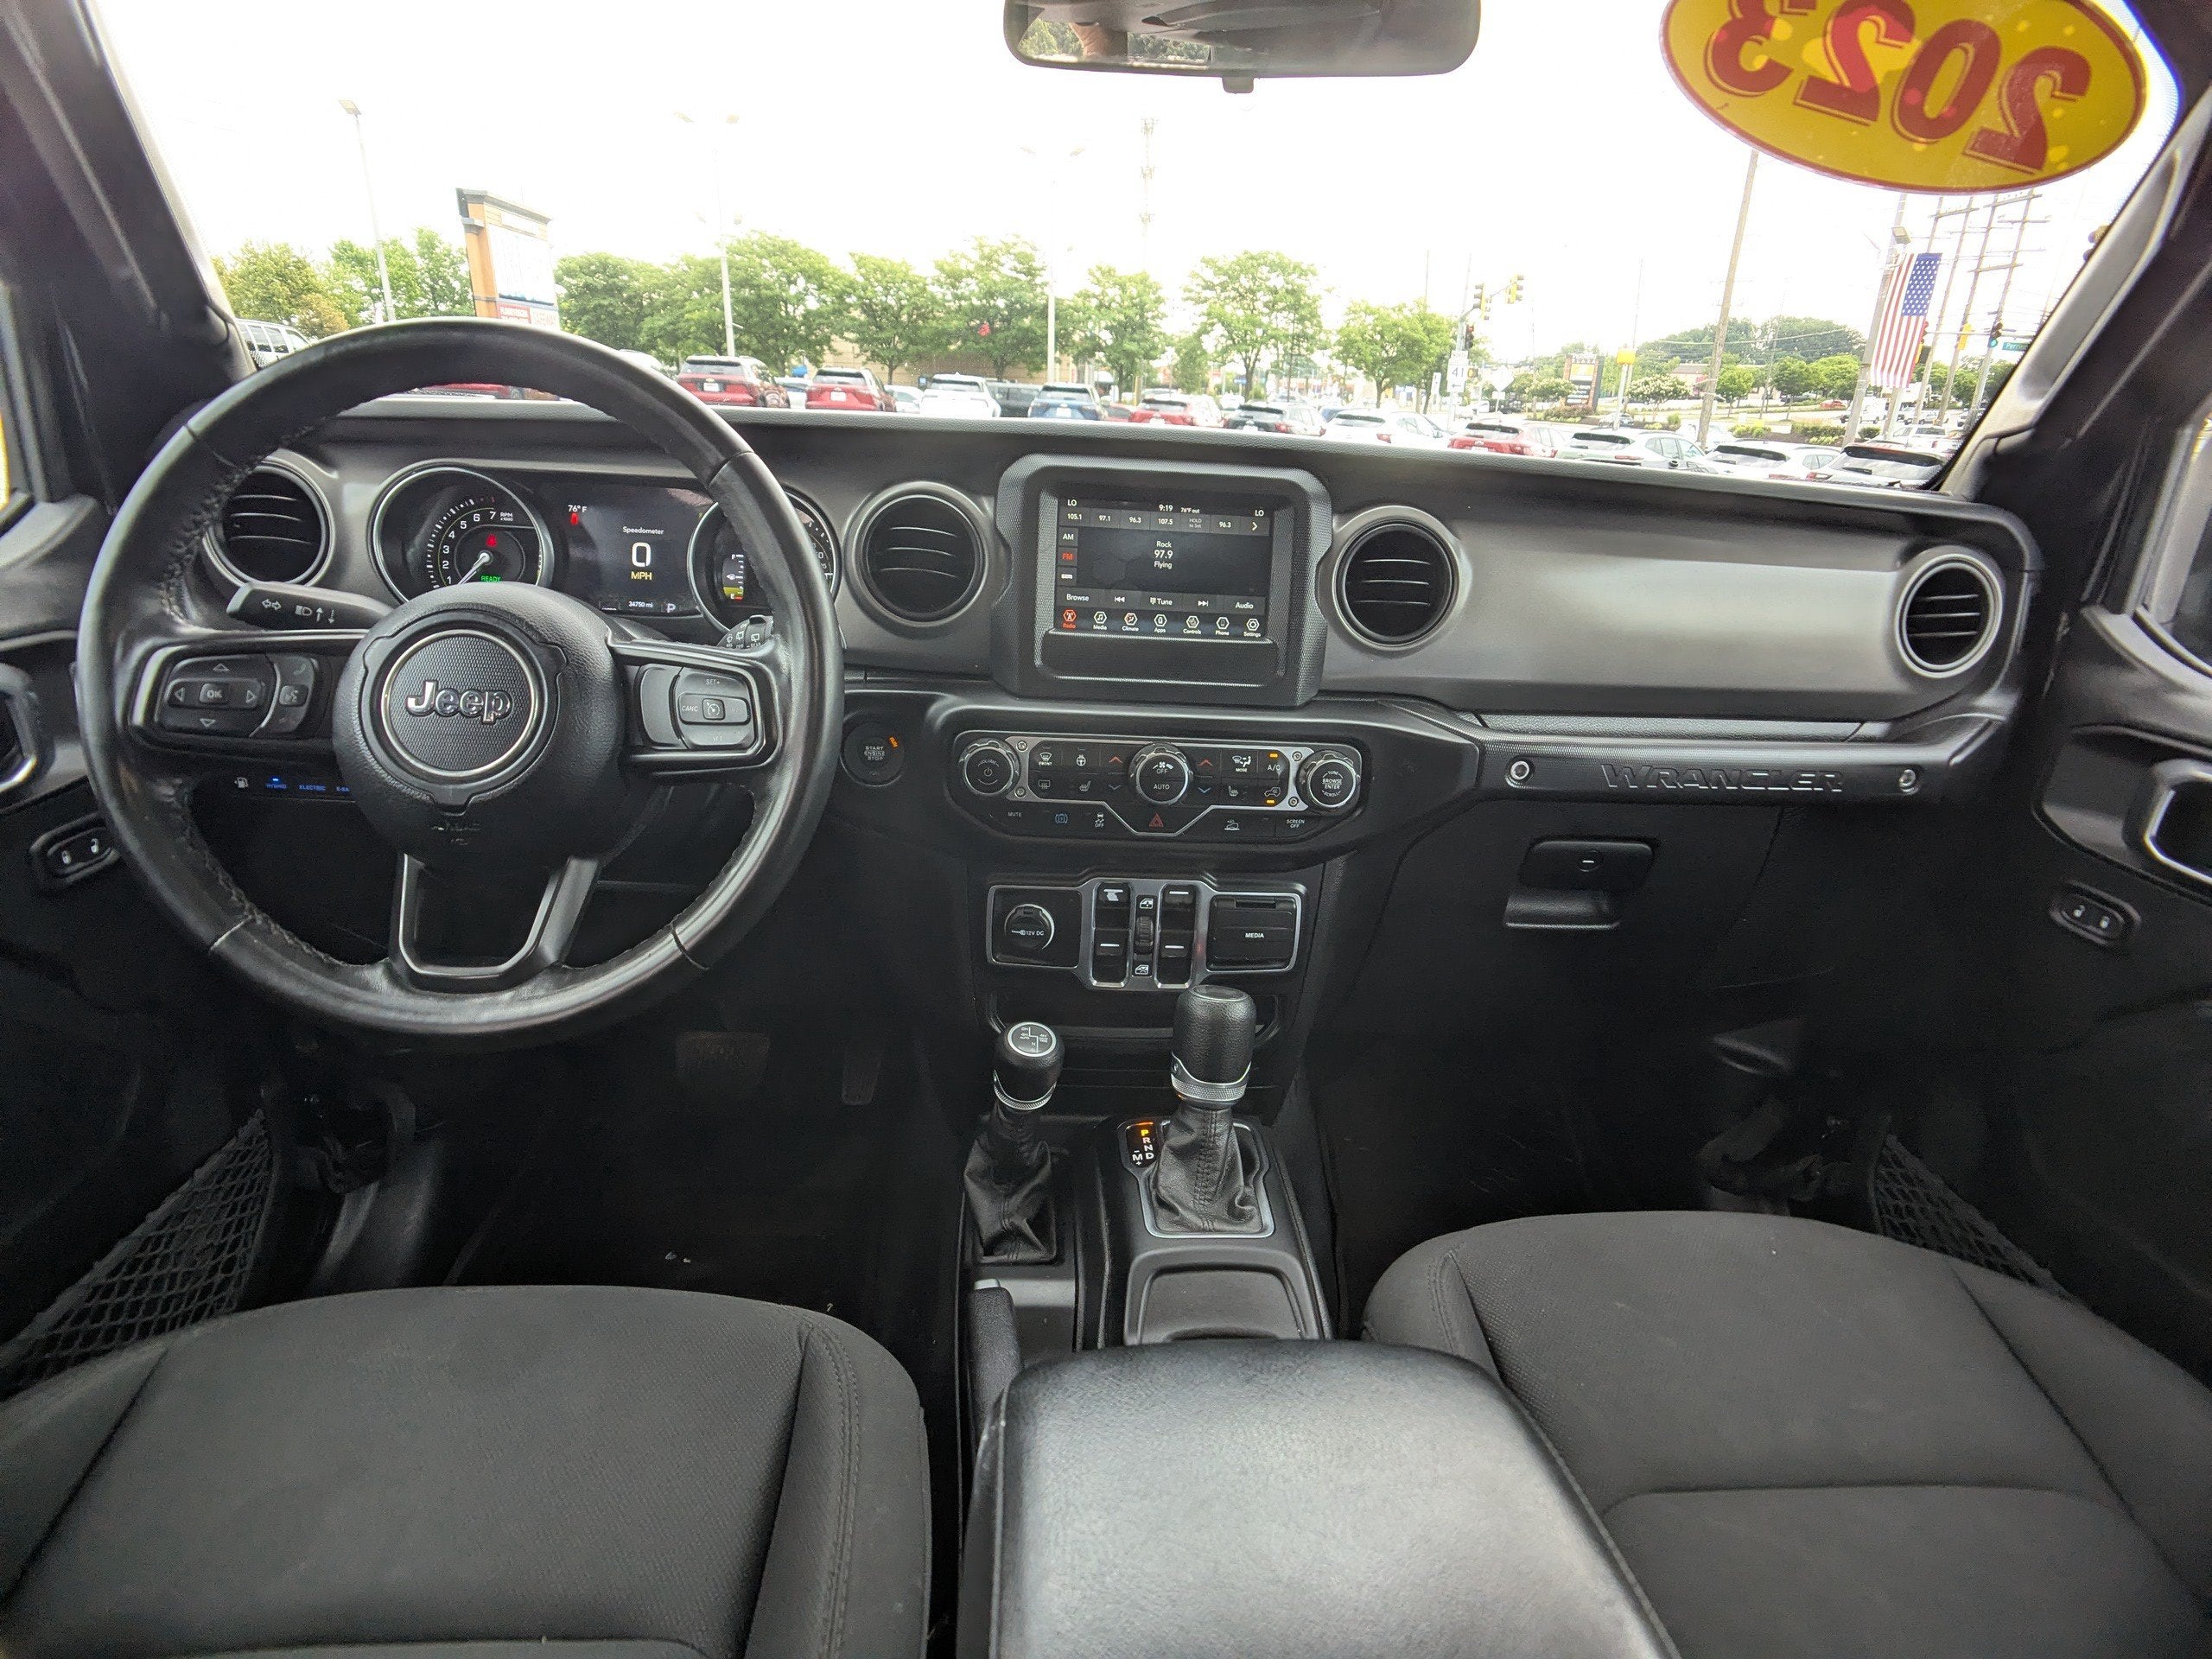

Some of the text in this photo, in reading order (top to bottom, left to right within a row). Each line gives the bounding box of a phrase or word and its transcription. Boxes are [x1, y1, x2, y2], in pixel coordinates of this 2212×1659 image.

[1452, 367, 1465, 378] 41
[489, 511, 496, 520] 7
[460, 521, 467, 529] 5
[623, 526, 664, 535] Speedometer
[632, 542, 651, 567] 0
[1154, 550, 1173, 559] 97.9
[1154, 561, 1172, 570] Flying
[631, 572, 652, 580] MPH
[666, 604, 676, 613] P
[207, 690, 222, 699] OK
[406, 680, 514, 723] Jeep
[1600, 763, 1844, 791] WRANGLER
